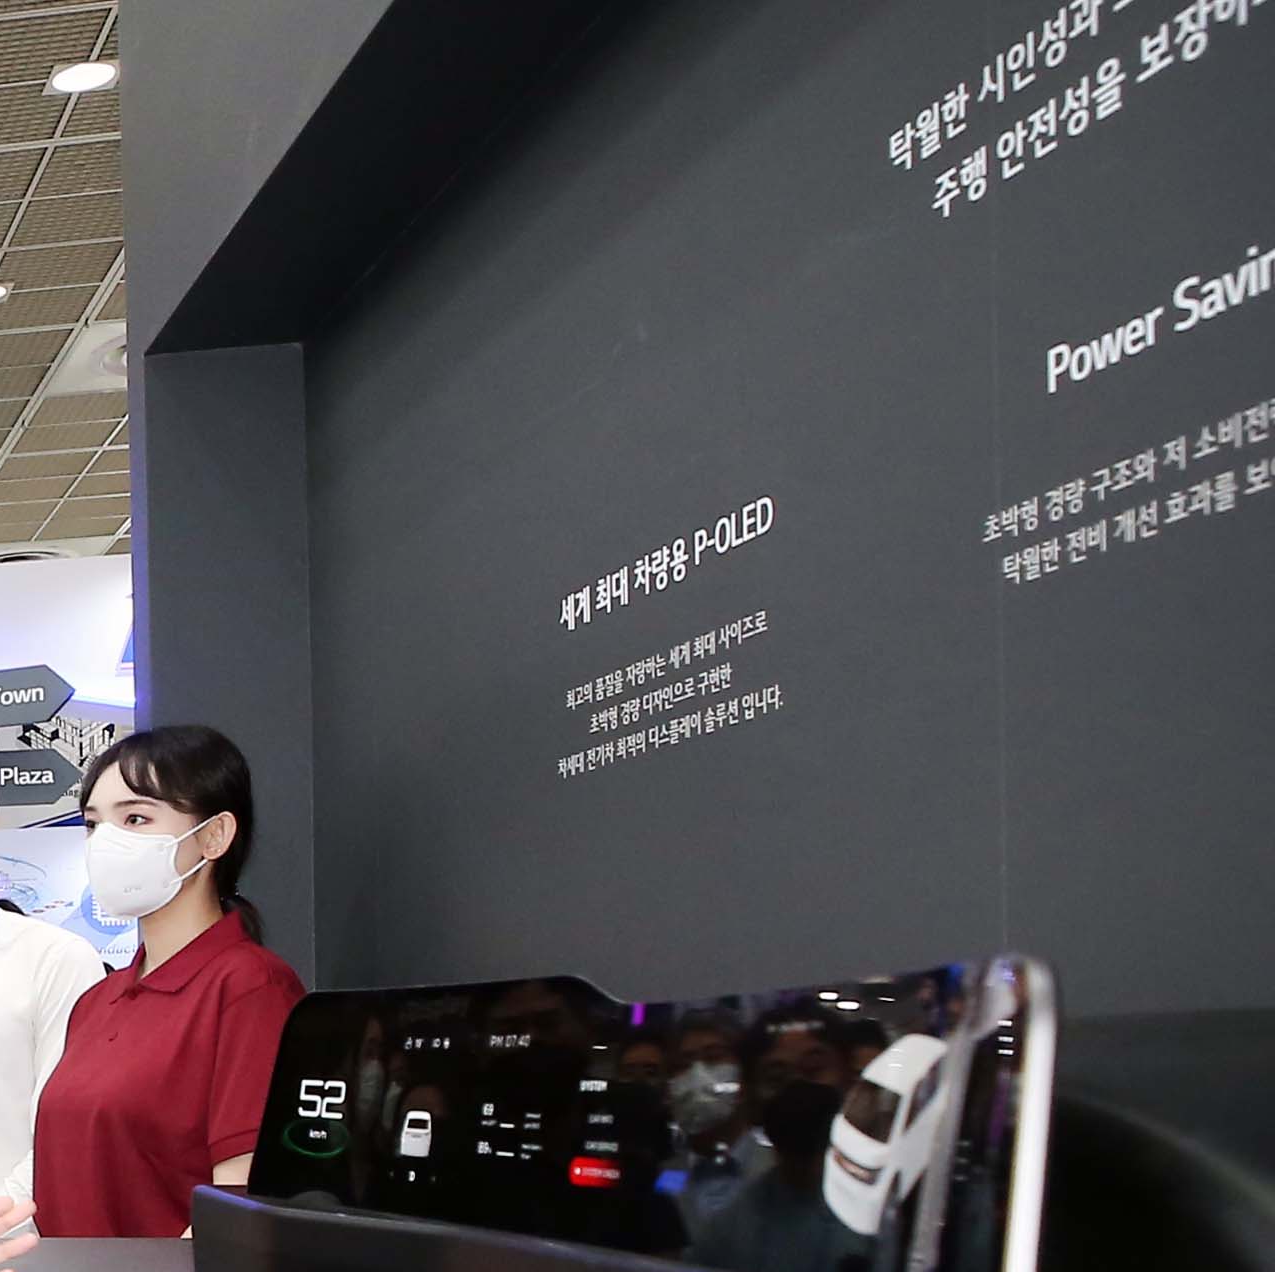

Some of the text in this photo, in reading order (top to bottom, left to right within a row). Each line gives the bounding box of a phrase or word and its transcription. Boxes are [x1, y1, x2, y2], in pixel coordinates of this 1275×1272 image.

[889, 0, 1104, 170] 탁월한 시인성과
[931, 146, 988, 218] 주행
[996, 57, 1126, 180] 안전성을
[1046, 305, 1165, 394] Power
[982, 398, 1275, 543] 초박형 경량 구조와 저 소비전
[1002, 456, 1275, 584] 탁월한 전비 개선 효과를 보
[558, 495, 774, 631] 세계 최대 차량용 P-OLED
[565, 609, 768, 711] 최고의 품질을 자랑하는 세계 최대 사이즈로
[588, 661, 733, 734] 초박형 경량 디자인으로 구현한
[0, 766, 55, 786] Plaza
[557, 683, 785, 779] 차세대 전기차 최적의 디스플레이 솔루션 입니다.
[298, 1079, 347, 1119] 52
